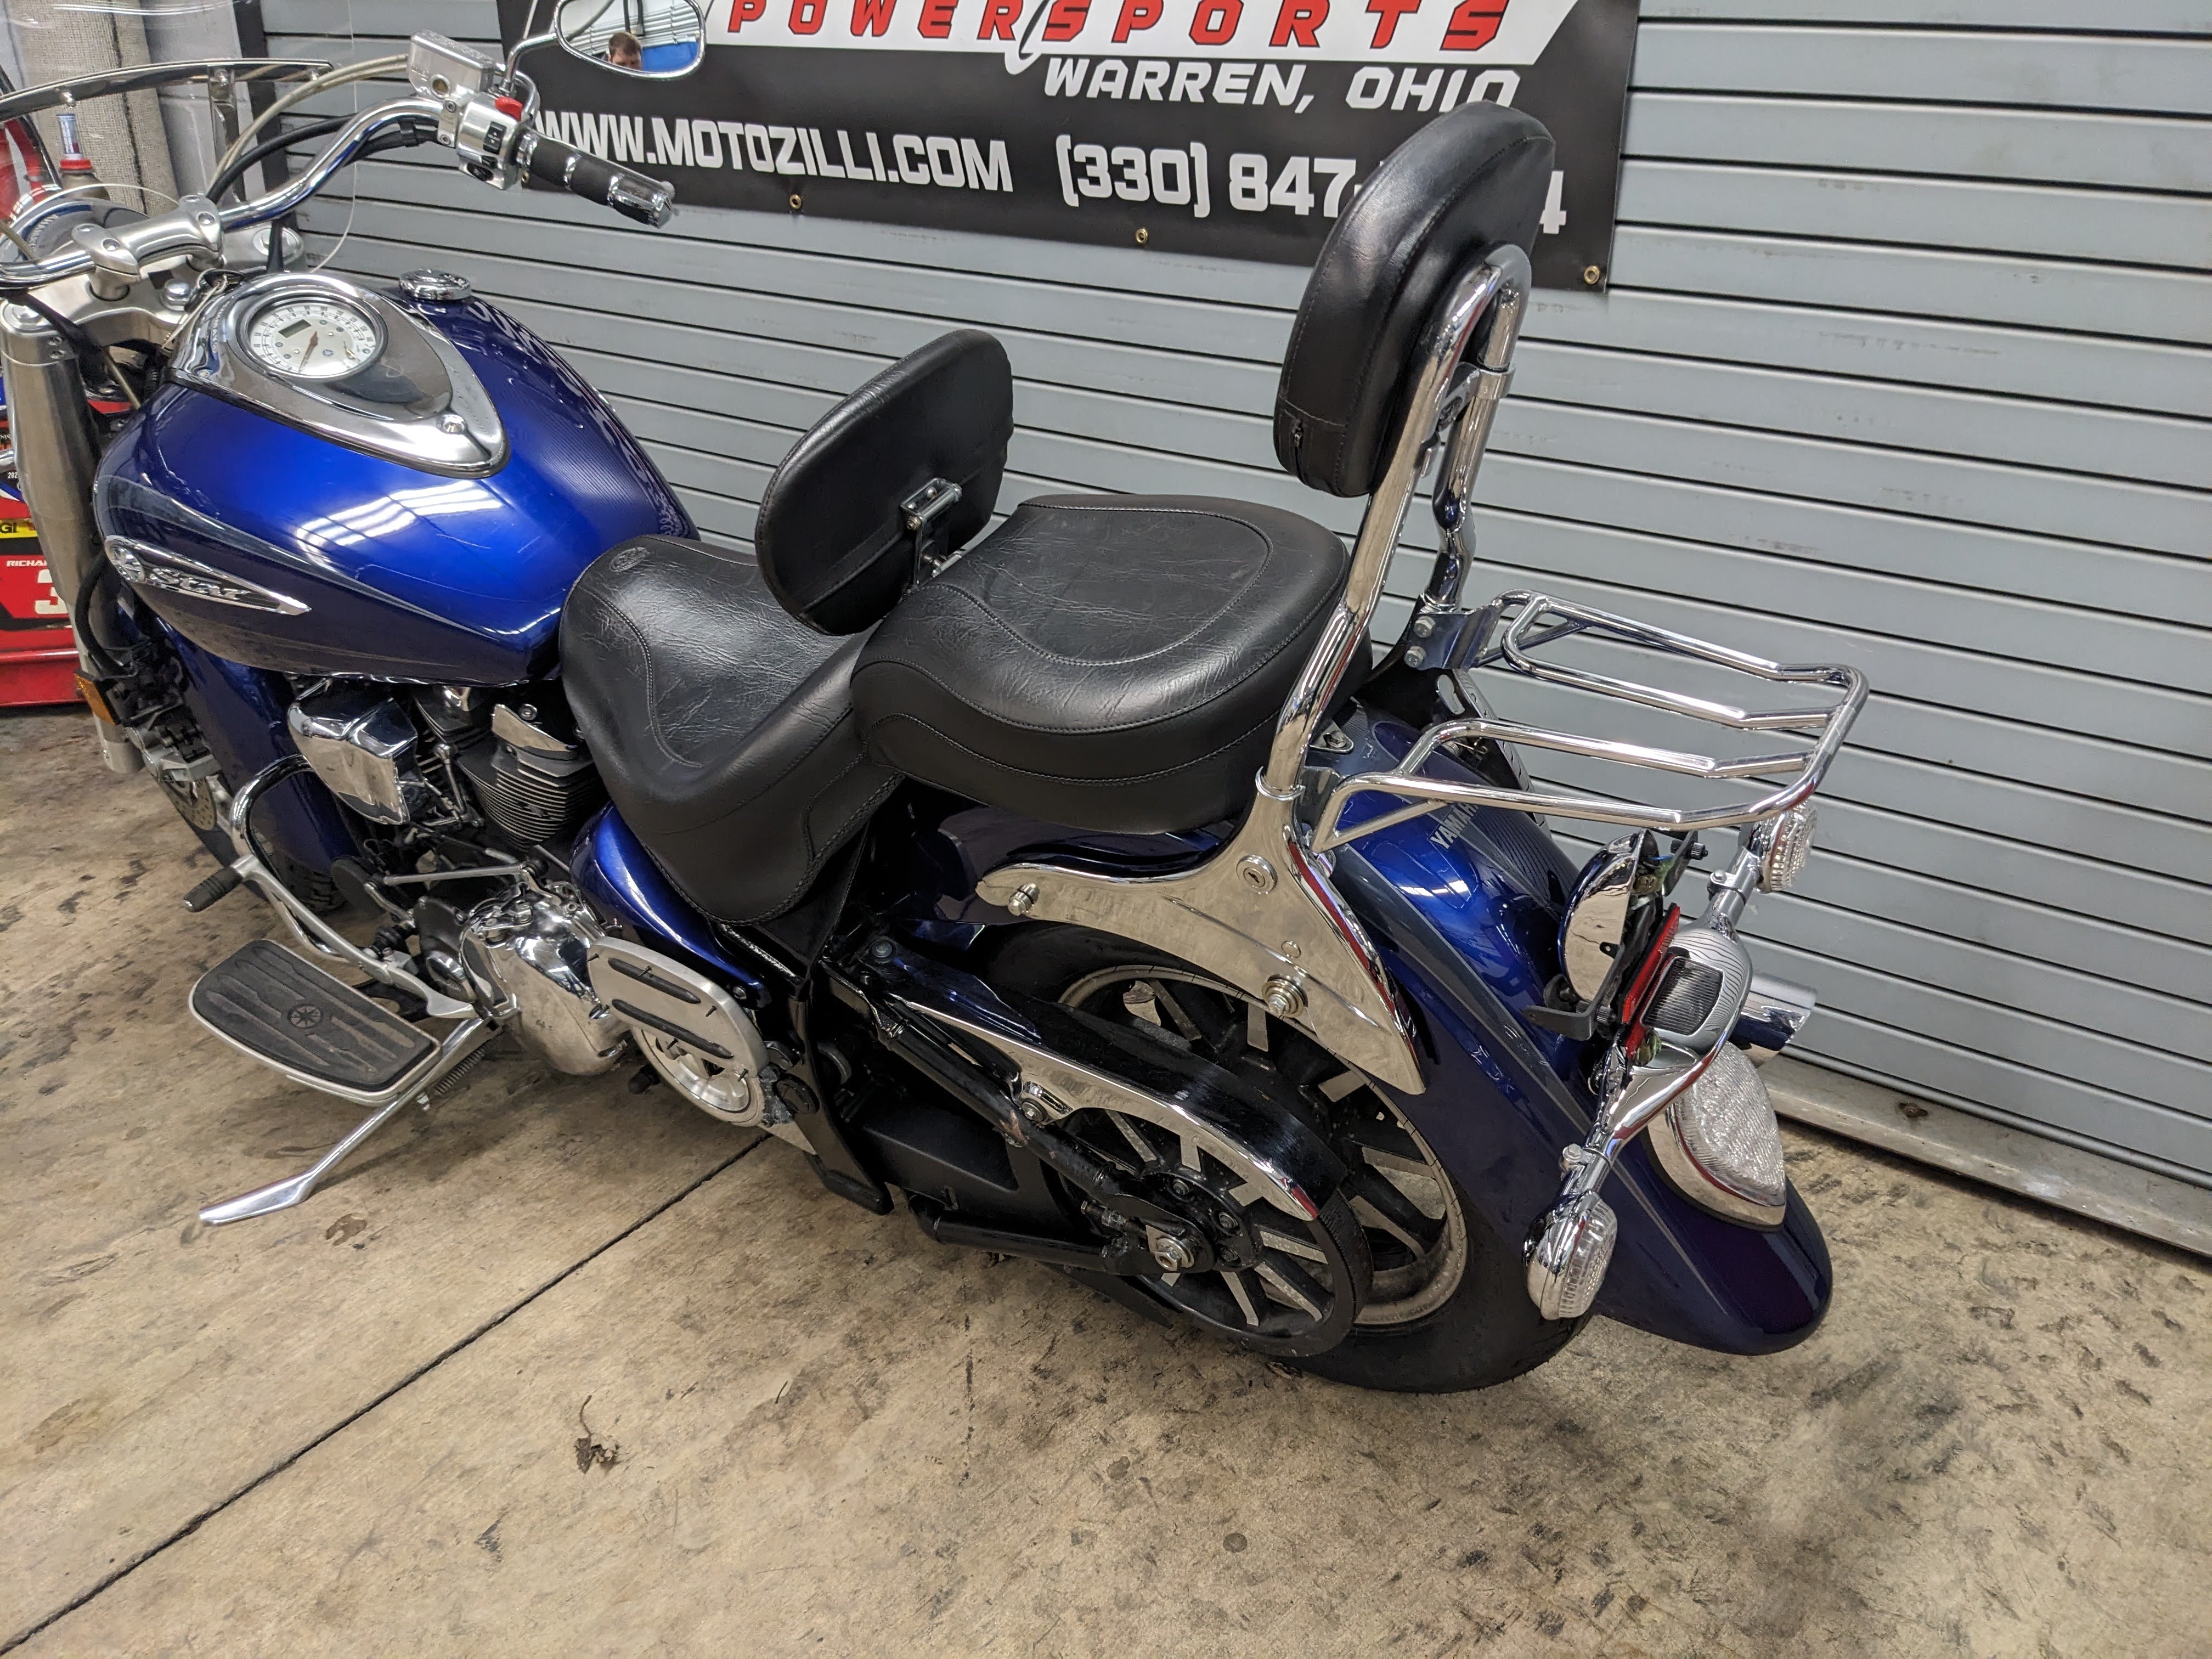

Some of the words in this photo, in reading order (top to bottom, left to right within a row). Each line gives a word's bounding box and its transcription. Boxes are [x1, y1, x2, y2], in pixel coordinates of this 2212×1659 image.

[1044, 58, 1315, 114] WARREN,
[1345, 66, 1520, 113] OHIO
[535, 110, 1014, 192] WWW.MOTOZILLI.COM
[1056, 134, 1210, 218] (330)
[1430, 802, 1479, 850] YAMAH
